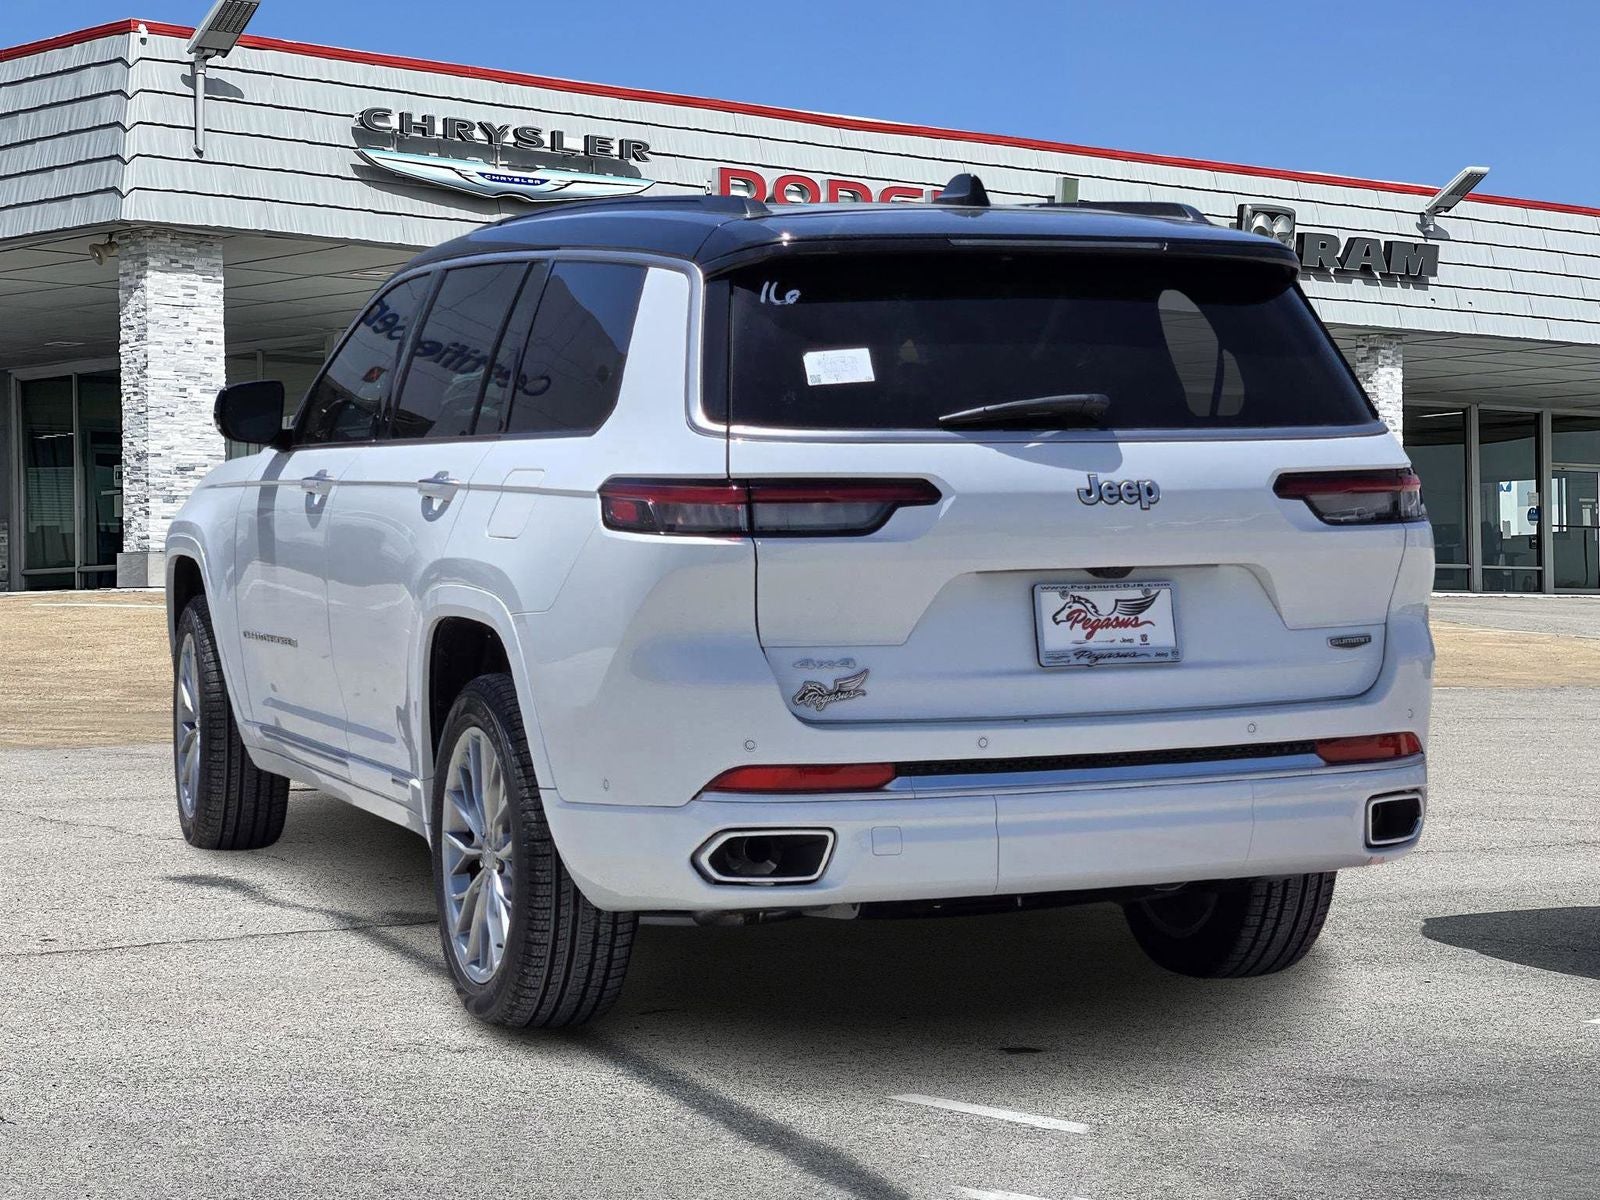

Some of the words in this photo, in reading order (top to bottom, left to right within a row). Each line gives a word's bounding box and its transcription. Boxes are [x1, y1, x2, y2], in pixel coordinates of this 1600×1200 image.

[355, 107, 652, 162] CHRYSLER
[484, 174, 541, 185] CHRYSLER
[1296, 232, 1440, 277] RAM
[760, 281, 801, 305] 16
[1077, 474, 1160, 510] Jeep
[1066, 608, 1155, 640] Pegasus
[1072, 649, 1151, 664] Pegasus
[803, 690, 866, 711] Pegasus
